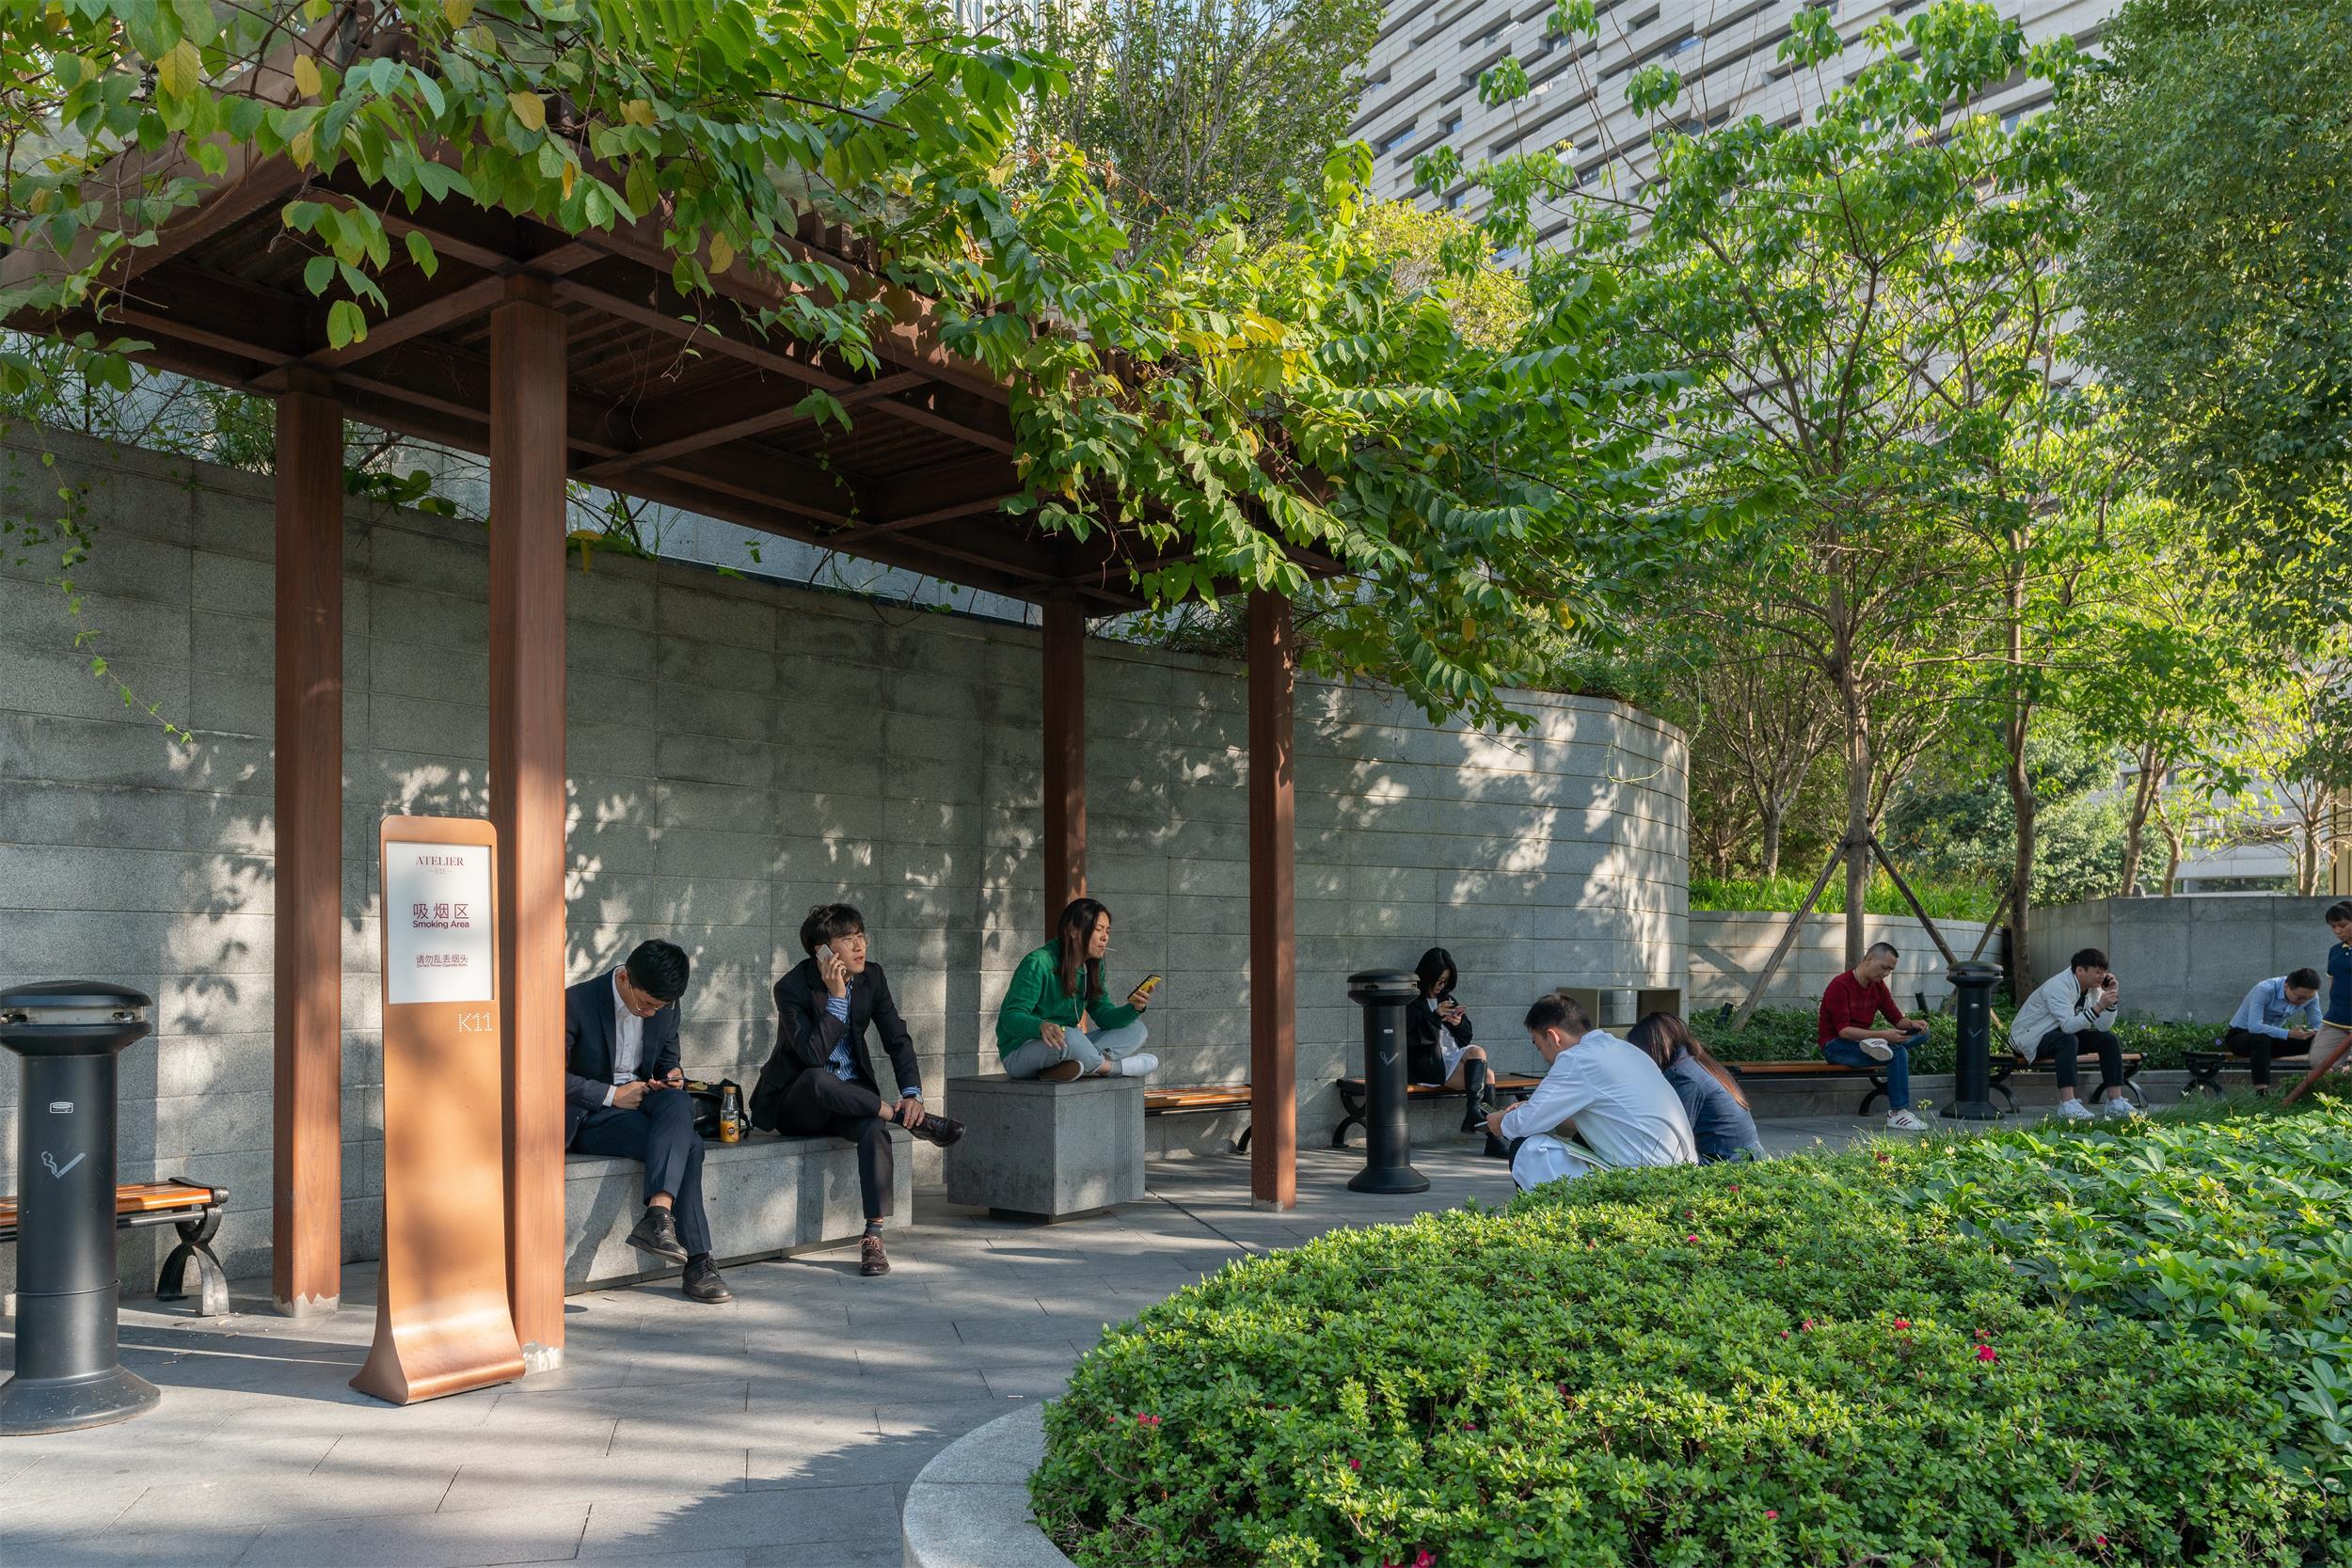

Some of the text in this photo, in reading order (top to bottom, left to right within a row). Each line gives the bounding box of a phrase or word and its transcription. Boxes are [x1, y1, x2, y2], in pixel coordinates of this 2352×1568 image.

[415, 856, 464, 866] ATELIER
[413, 903, 469, 920] 吸烟区
[413, 920, 469, 929] Smoking Area
[416, 954, 469, 964] 请勿乱丢烟头
[459, 1012, 493, 1033] K11
